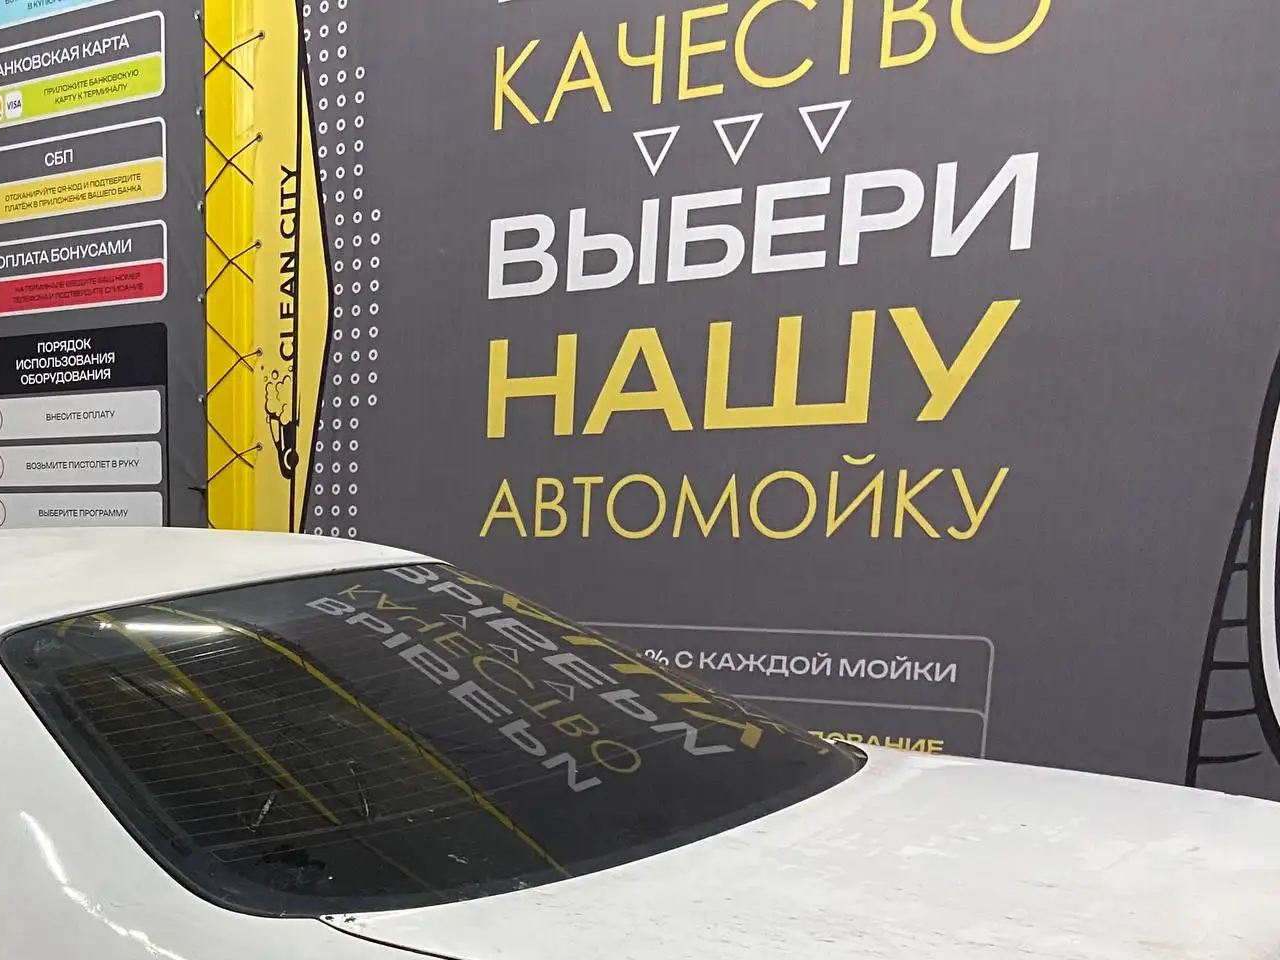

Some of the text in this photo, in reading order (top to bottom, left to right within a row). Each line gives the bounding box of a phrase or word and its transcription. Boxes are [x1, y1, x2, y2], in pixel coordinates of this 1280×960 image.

[82, 34, 130, 58] КАРТА
[43, 69, 139, 96] ПРИЛОЖИТЕ БАНКОВСКУЮ
[55, 83, 128, 105] КАРТУ К ТЕРМИНАЛУ
[6, 100, 22, 110] VISA
[44, 149, 73, 167] СБП
[83, 181, 89, 189] И
[90, 173, 141, 188] ПОДТВЕРДИТЕ
[88, 189, 116, 200] ВАШЕГО
[117, 185, 142, 197] БАНКА
[487, 151, 1039, 300] ВЫБЕРИ
[51, 238, 132, 263] БОНУСАМИ
[280, 165, 299, 361] CLEAN CITY
[37, 337, 91, 354] ПОРЯДОК
[16, 352, 115, 370] ИСПОЛЬЗОВАНИЯ
[486, 299, 1021, 438] НАШУ
[20, 368, 111, 385] ОБОРУДОВАНИЯ
[46, 412, 82, 421] ВНЕСИТЕ
[82, 410, 115, 420] ОПЛАТУ
[26, 461, 68, 470] ВОЗЬМИТЕ
[68, 461, 111, 469] ПИСТОЛЕТ
[119, 460, 140, 469] РУКУ
[479, 453, 1009, 540] АВТОМОЙКУ
[38, 509, 78, 518] ВЫБЕРИТЕ
[79, 509, 128, 518] ПРОГРАММУ
[675, 651, 693, 669] С
[699, 652, 832, 677] КАЖДОЙ
[839, 656, 957, 683] МОЙКИ
